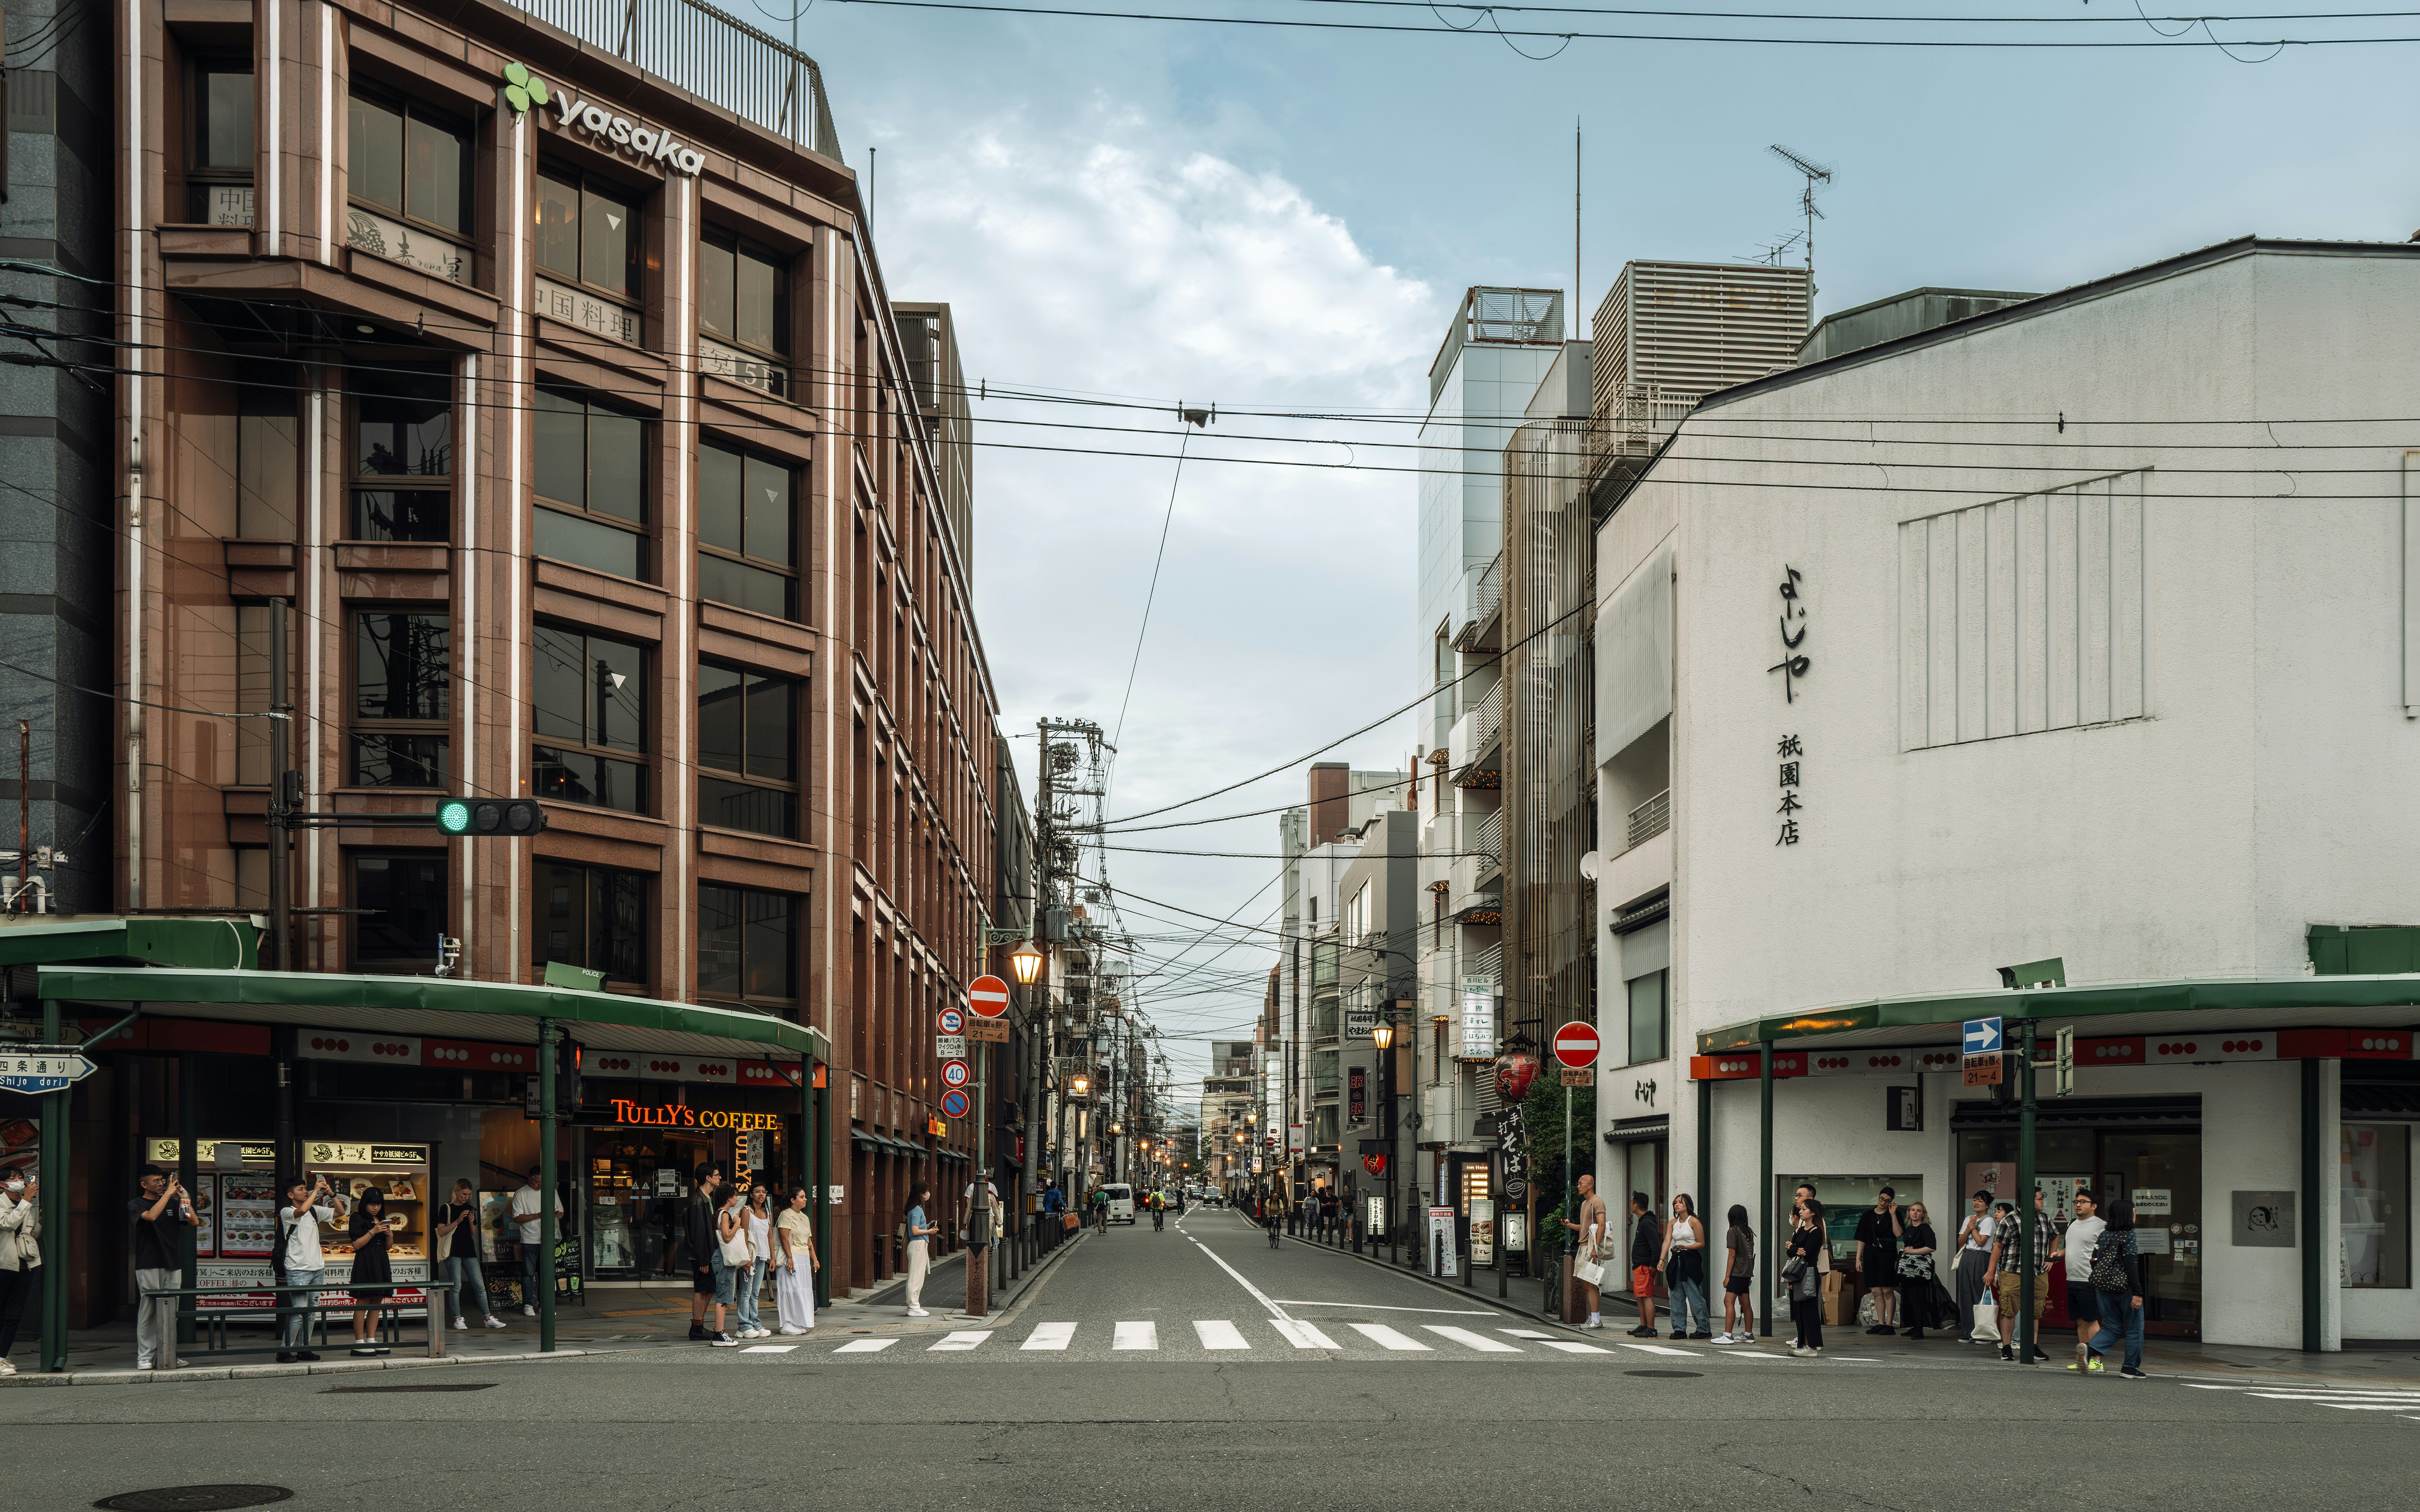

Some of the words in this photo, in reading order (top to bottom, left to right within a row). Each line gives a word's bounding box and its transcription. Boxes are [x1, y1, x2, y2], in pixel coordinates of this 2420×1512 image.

[552, 90, 706, 176] yasaka
[745, 363, 774, 392] 5F
[1775, 734, 1803, 847] 祇園本店
[969, 1019, 1007, 1030] 自転車を除く
[0, 1060, 65, 1073] 四条通り
[1964, 1055, 2000, 1069] 自転車を除く
[948, 1068, 963, 1080] 40
[0, 1076, 27, 1087] Shijo
[39, 1077, 62, 1086] dori
[700, 1111, 777, 1130] COFFEE
[373, 1149, 417, 1159] ヤサカ祇園ビル5F
[1502, 1131, 1523, 1175] そば
